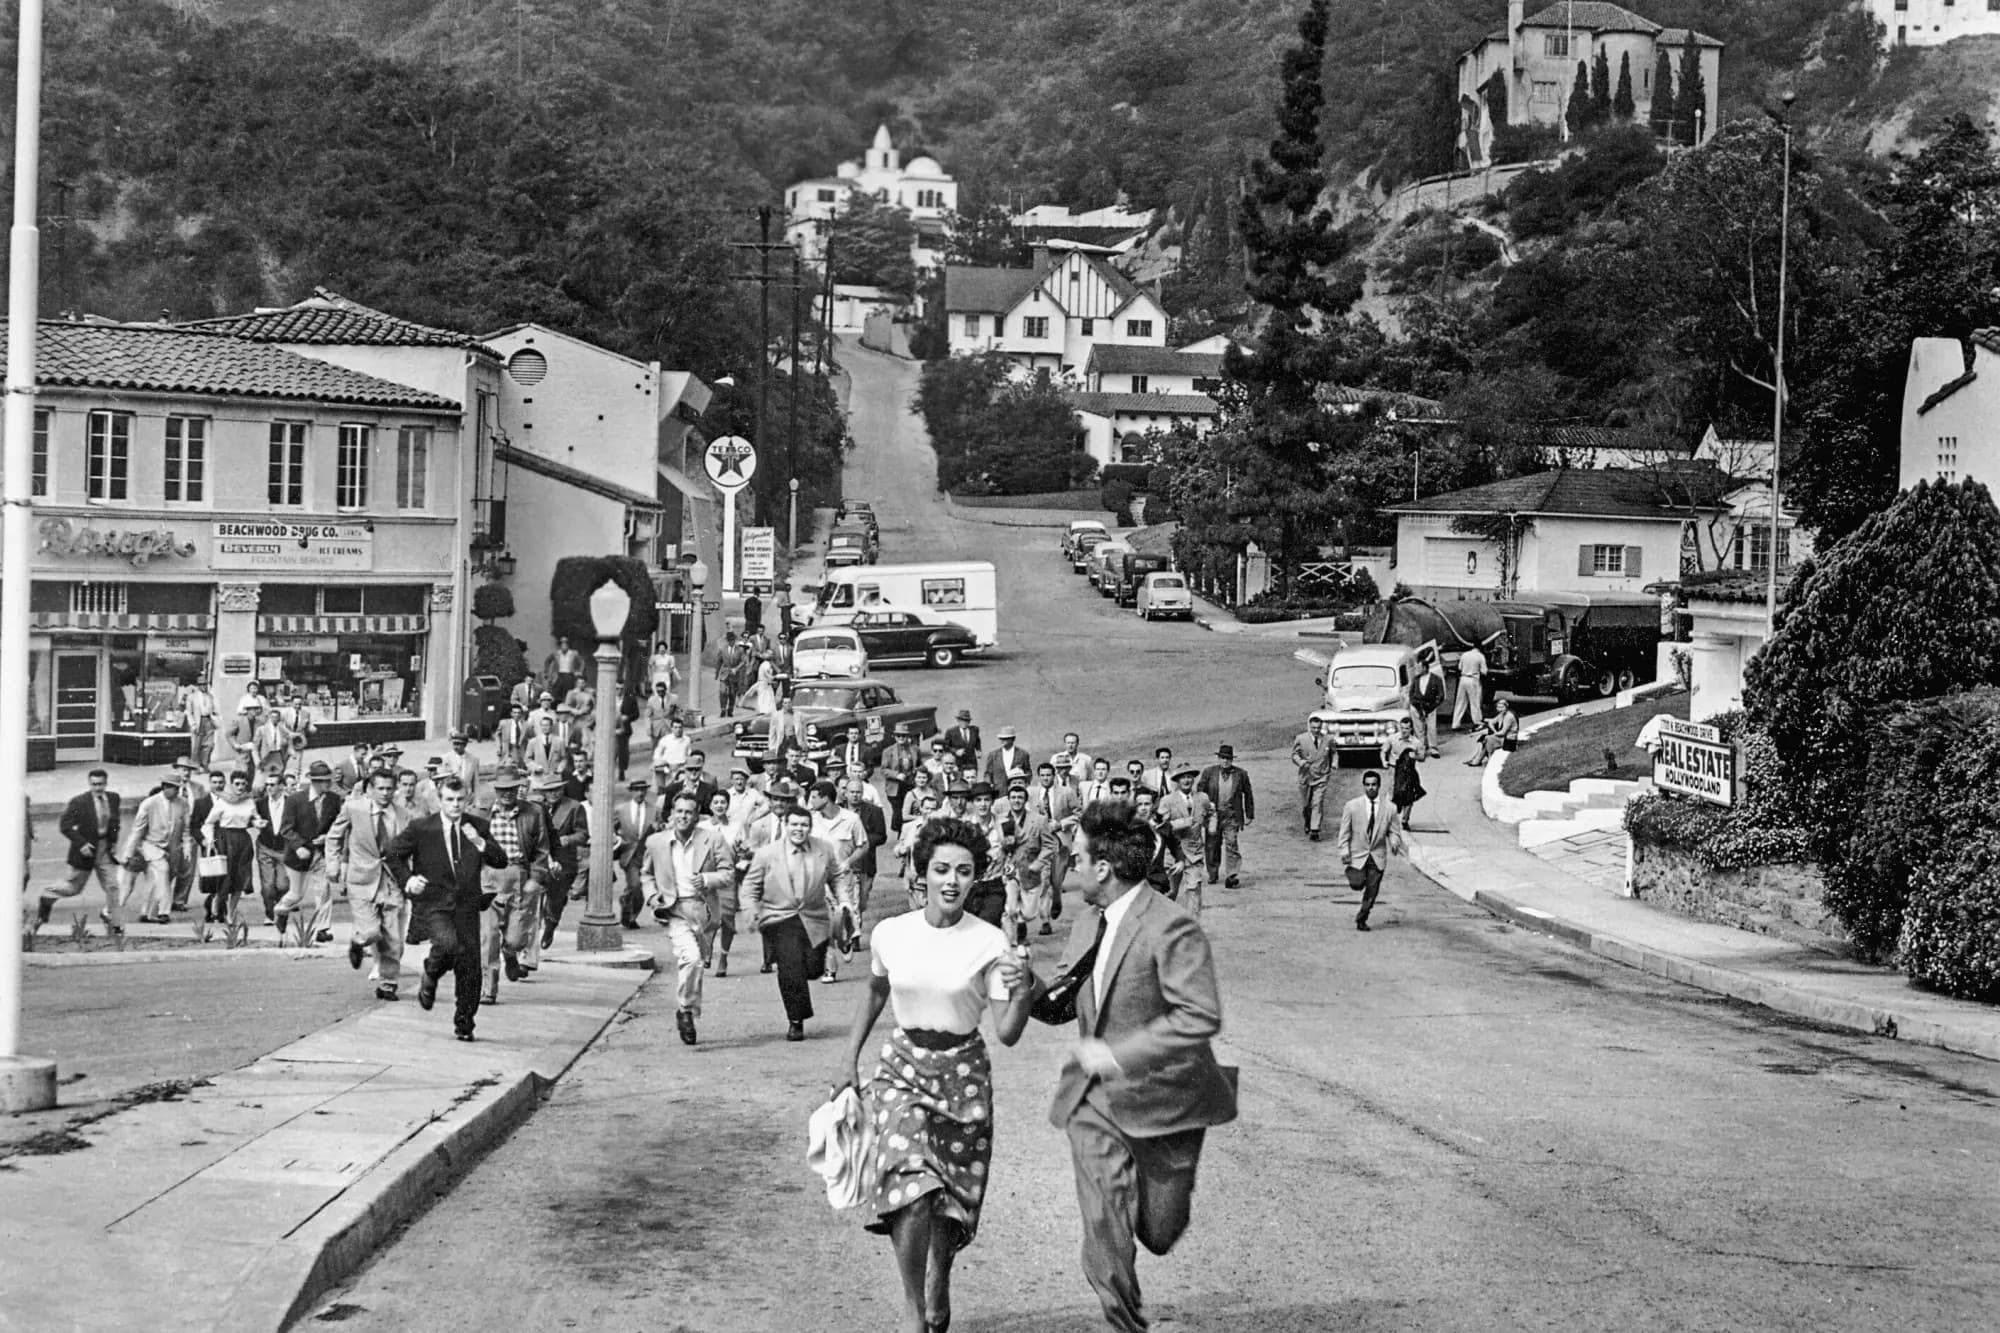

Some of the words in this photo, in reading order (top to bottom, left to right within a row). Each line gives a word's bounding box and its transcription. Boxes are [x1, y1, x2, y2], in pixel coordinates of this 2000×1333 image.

[711, 445, 752, 454] TEXACO
[219, 524, 288, 537] BEACHWOOD
[291, 525, 319, 538] DRUG
[322, 526, 339, 538] CO.
[319, 547, 331, 555] ICE
[333, 547, 363, 556] CREAMS
[251, 555, 297, 565] FOUNTAIN
[299, 556, 335, 566] SERVICE
[1674, 721, 1699, 738] BEACHWOOD
[1699, 726, 1713, 741] DRIVE
[1657, 739, 1685, 770] REAL
[1686, 745, 1730, 780] ESTATE
[1665, 767, 1721, 796] HOLLYWOODLAND
